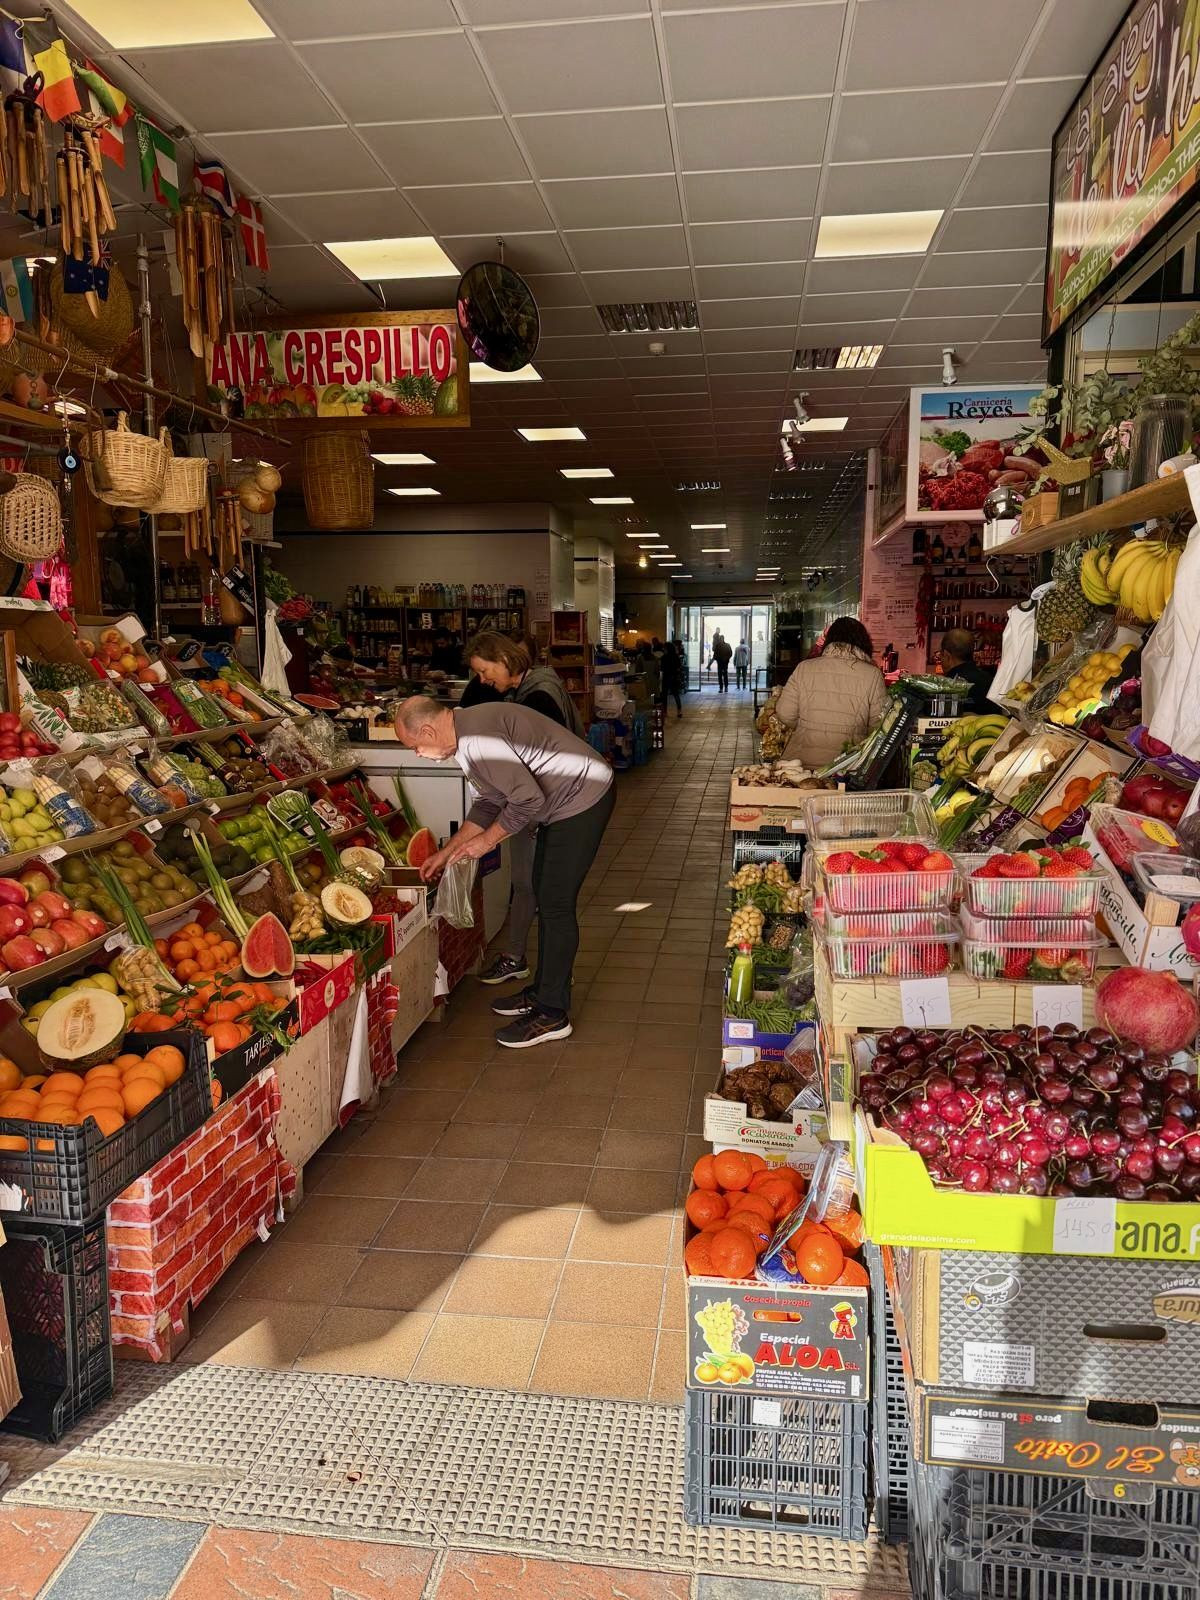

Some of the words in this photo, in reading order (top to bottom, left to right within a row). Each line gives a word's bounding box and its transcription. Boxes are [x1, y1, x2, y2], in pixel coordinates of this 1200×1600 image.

[1112, 101, 1155, 203] la
[211, 333, 271, 389] ANA
[284, 325, 451, 386] CRESPILLO
[946, 401, 1014, 423] Reyes
[729, 1280, 769, 1288] ALOA
[743, 1294, 780, 1304] Cosecha
[781, 1298, 812, 1308] propia
[759, 1332, 810, 1345] Especial
[753, 1341, 845, 1373] ALOA
[1001, 1409, 1018, 1421] los
[1035, 1414, 1062, 1424] pero
[1013, 1436, 1102, 1469] Osito
[1105, 1444, 1166, 1474] El
